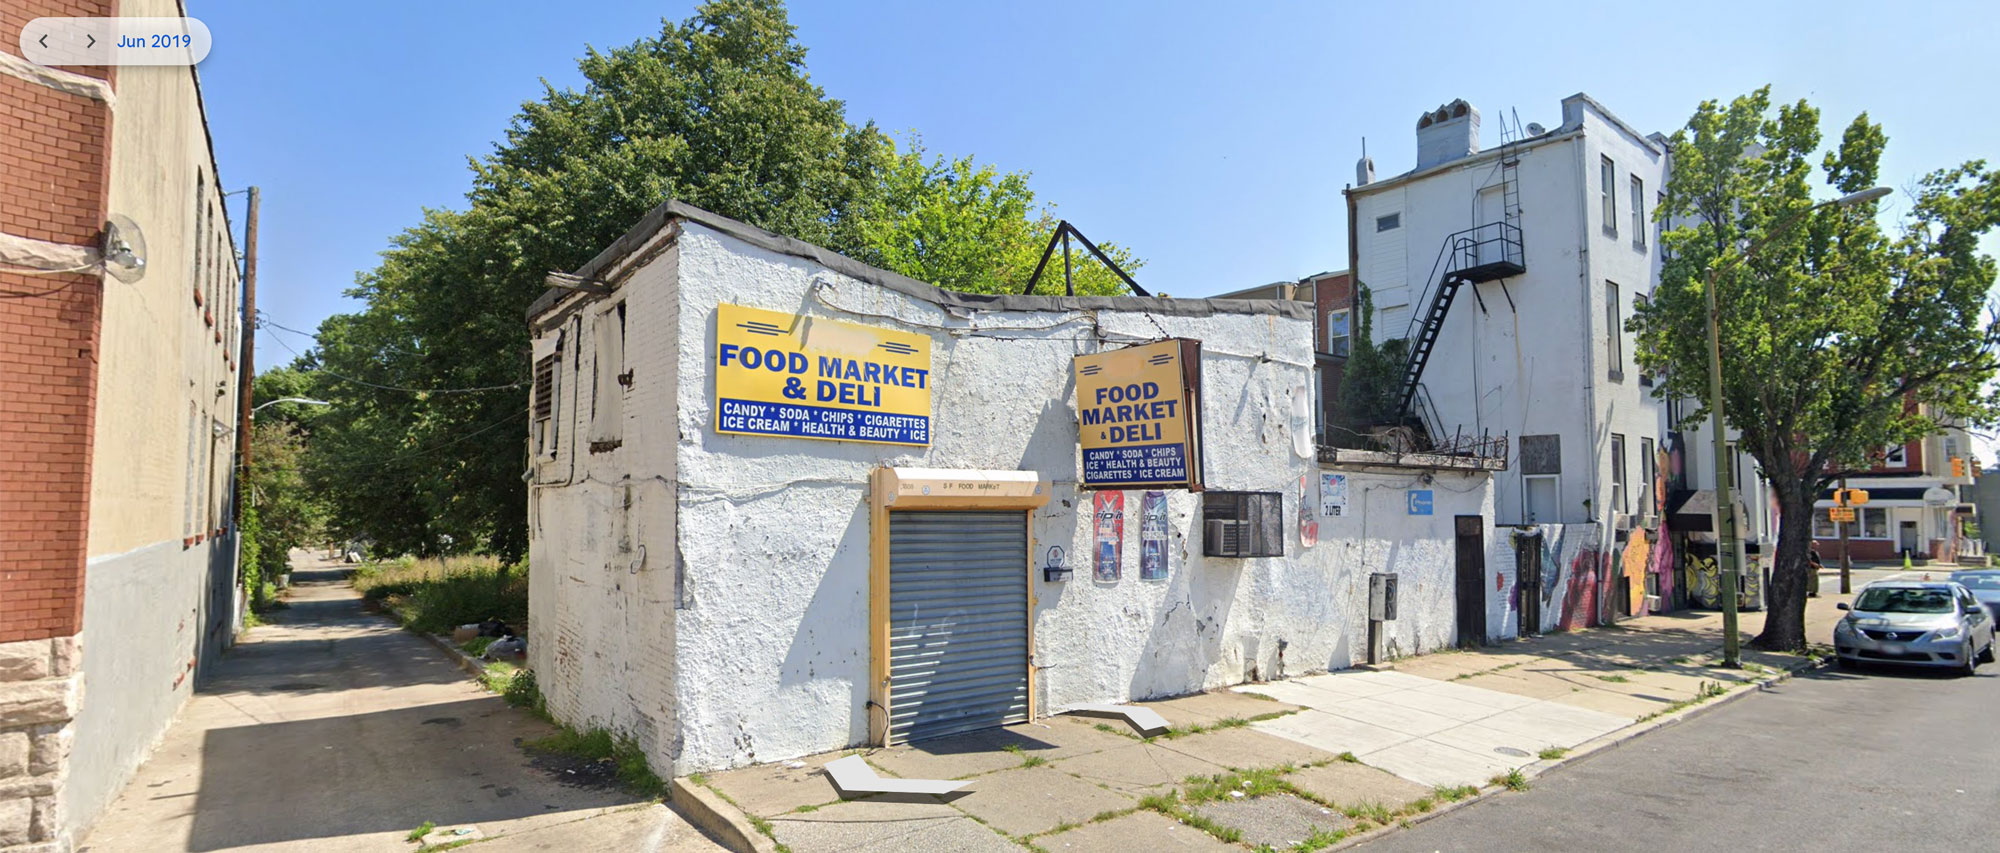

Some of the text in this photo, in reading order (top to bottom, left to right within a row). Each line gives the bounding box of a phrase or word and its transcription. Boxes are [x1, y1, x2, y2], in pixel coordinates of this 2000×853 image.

[719, 343, 929, 389] FOOD MARKET
[782, 376, 881, 407] & DELI
[1095, 382, 1159, 405] FOOD
[723, 402, 926, 429] CANDY SODA CHIPS CIGARETTES
[1082, 400, 1178, 425] MARKET
[723, 415, 926, 441] ICE CREAM HEALTH & BEAUTY ICE
[1100, 423, 1162, 443] & DELI
[1086, 457, 1182, 470] ICE HEALTH & BEAUTY
[1089, 447, 1176, 460] CANDY SODA CHIPS
[1086, 468, 1185, 480] CIGARETTES ICE CREAM
